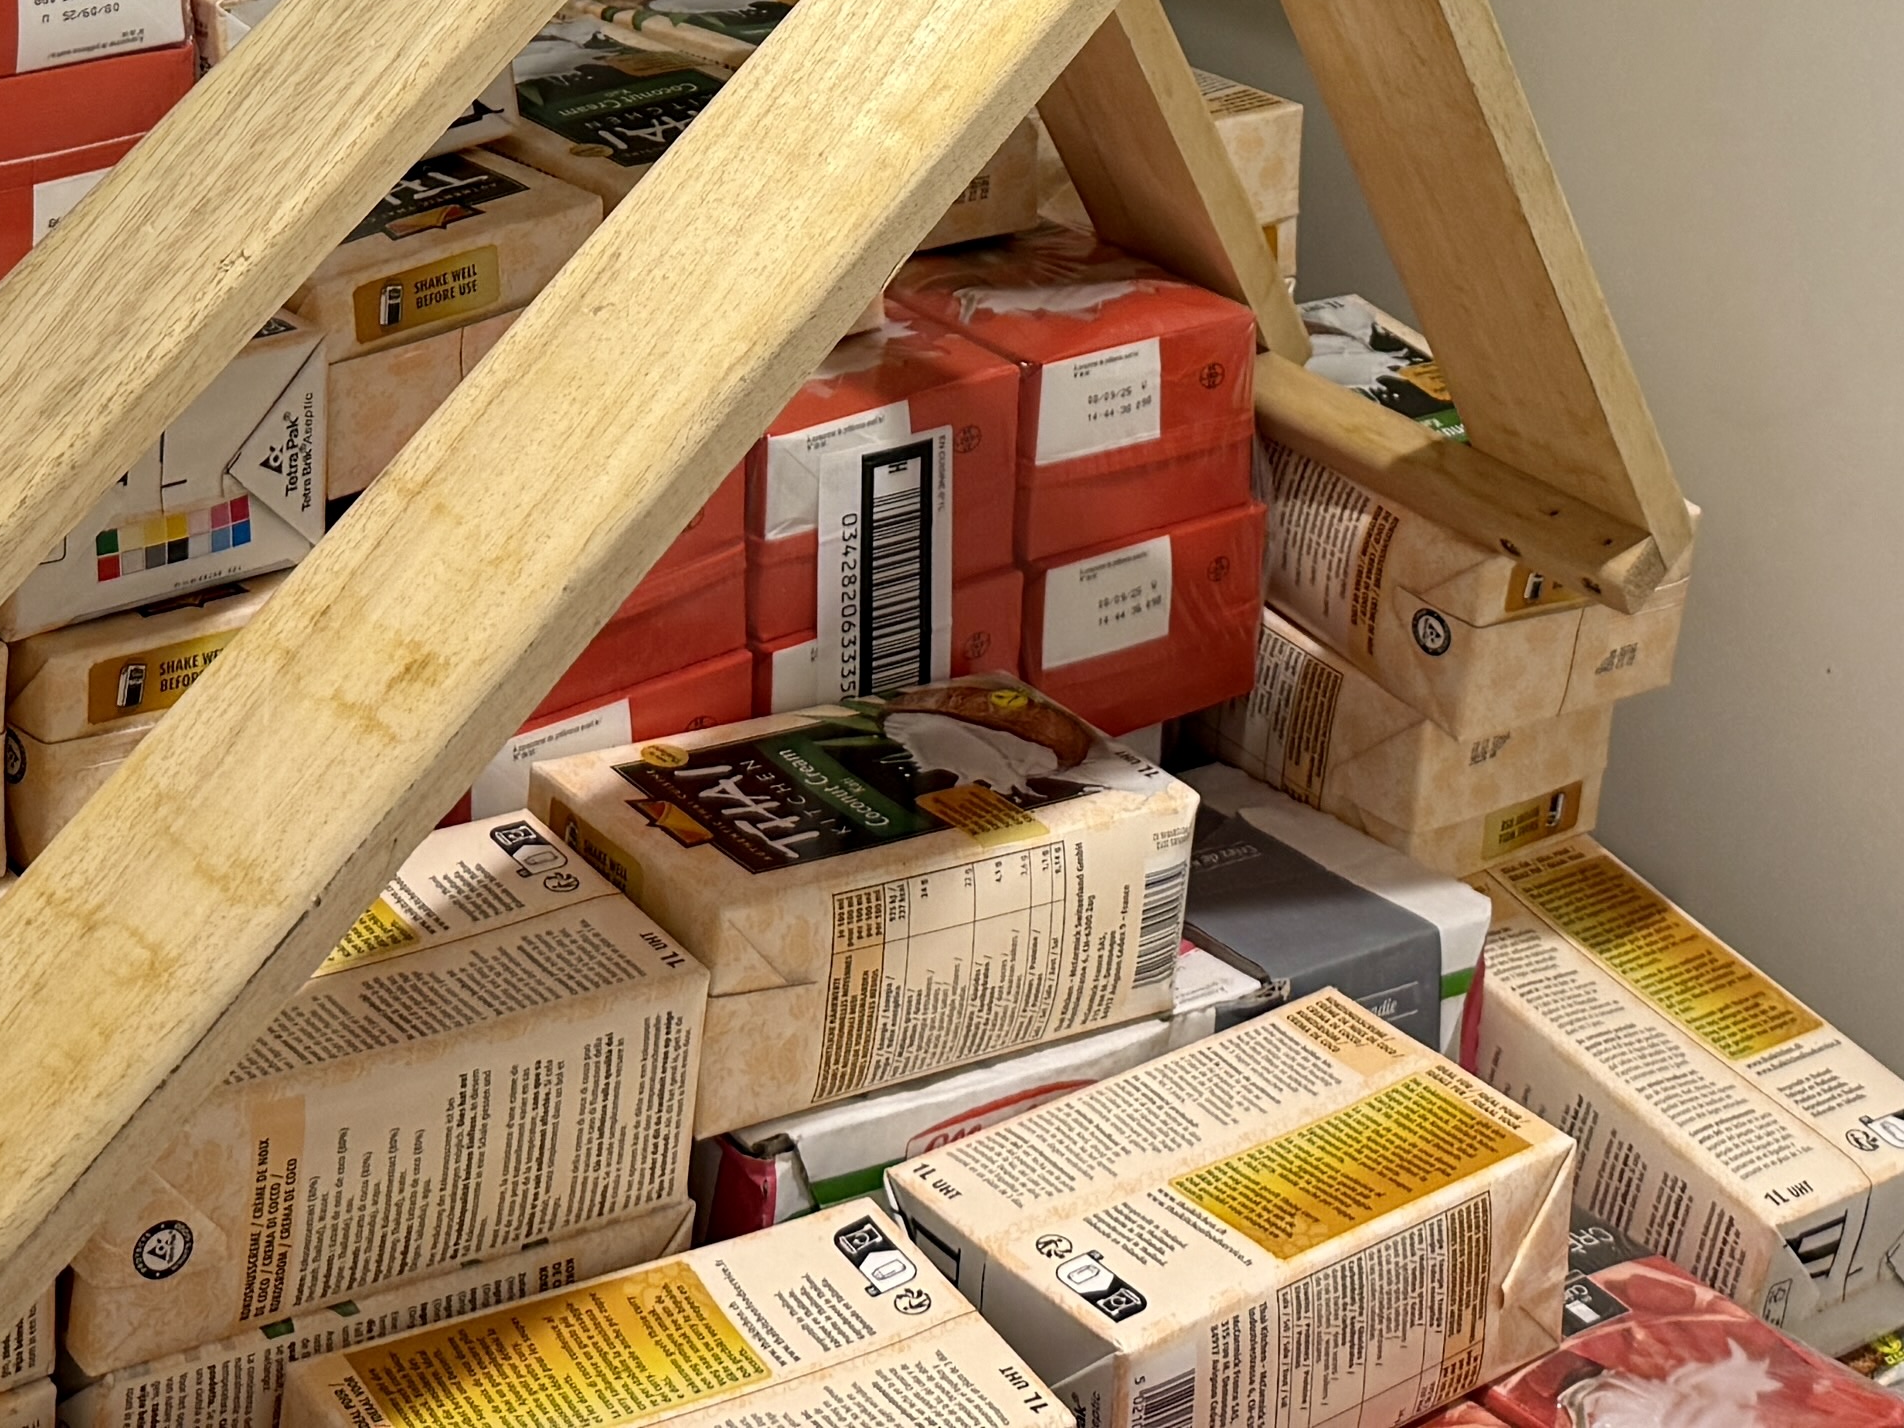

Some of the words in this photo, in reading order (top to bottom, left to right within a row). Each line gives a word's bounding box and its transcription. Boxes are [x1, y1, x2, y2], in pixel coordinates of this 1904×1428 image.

[414, 272, 449, 294] SHAKE
[451, 264, 478, 282] WELL
[416, 287, 455, 309] BEFORE
[459, 280, 478, 296] USE
[302, 392, 314, 444] Aseptic
[284, 452, 299, 496] Tetra
[301, 478, 311, 511] Tetra
[160, 655, 199, 676] SHAKE
[779, 748, 828, 786] Cream
[674, 764, 820, 859] THAI
[740, 759, 851, 836] KITCHEN
[823, 782, 890, 827] Coconut
[256, 1136, 271, 1166] NOIX
[255, 1166, 268, 1183] DE
[283, 1156, 299, 1186] COCO
[910, 1160, 934, 1183] 1L
[931, 1178, 965, 1200] UHT
[265, 1180, 282, 1215] COCCO
[282, 1186, 295, 1202] DE
[1762, 1185, 1789, 1208] 1L
[1788, 1178, 1816, 1199] UHT
[265, 1215, 278, 1229] DI
[277, 1202, 294, 1239] CREMA
[259, 1229, 277, 1267] CREMA
[255, 1276, 271, 1303] COCO
[253, 1302, 266, 1318] DE
[997, 1363, 1027, 1388] UHT
[1024, 1390, 1054, 1415] 1L
